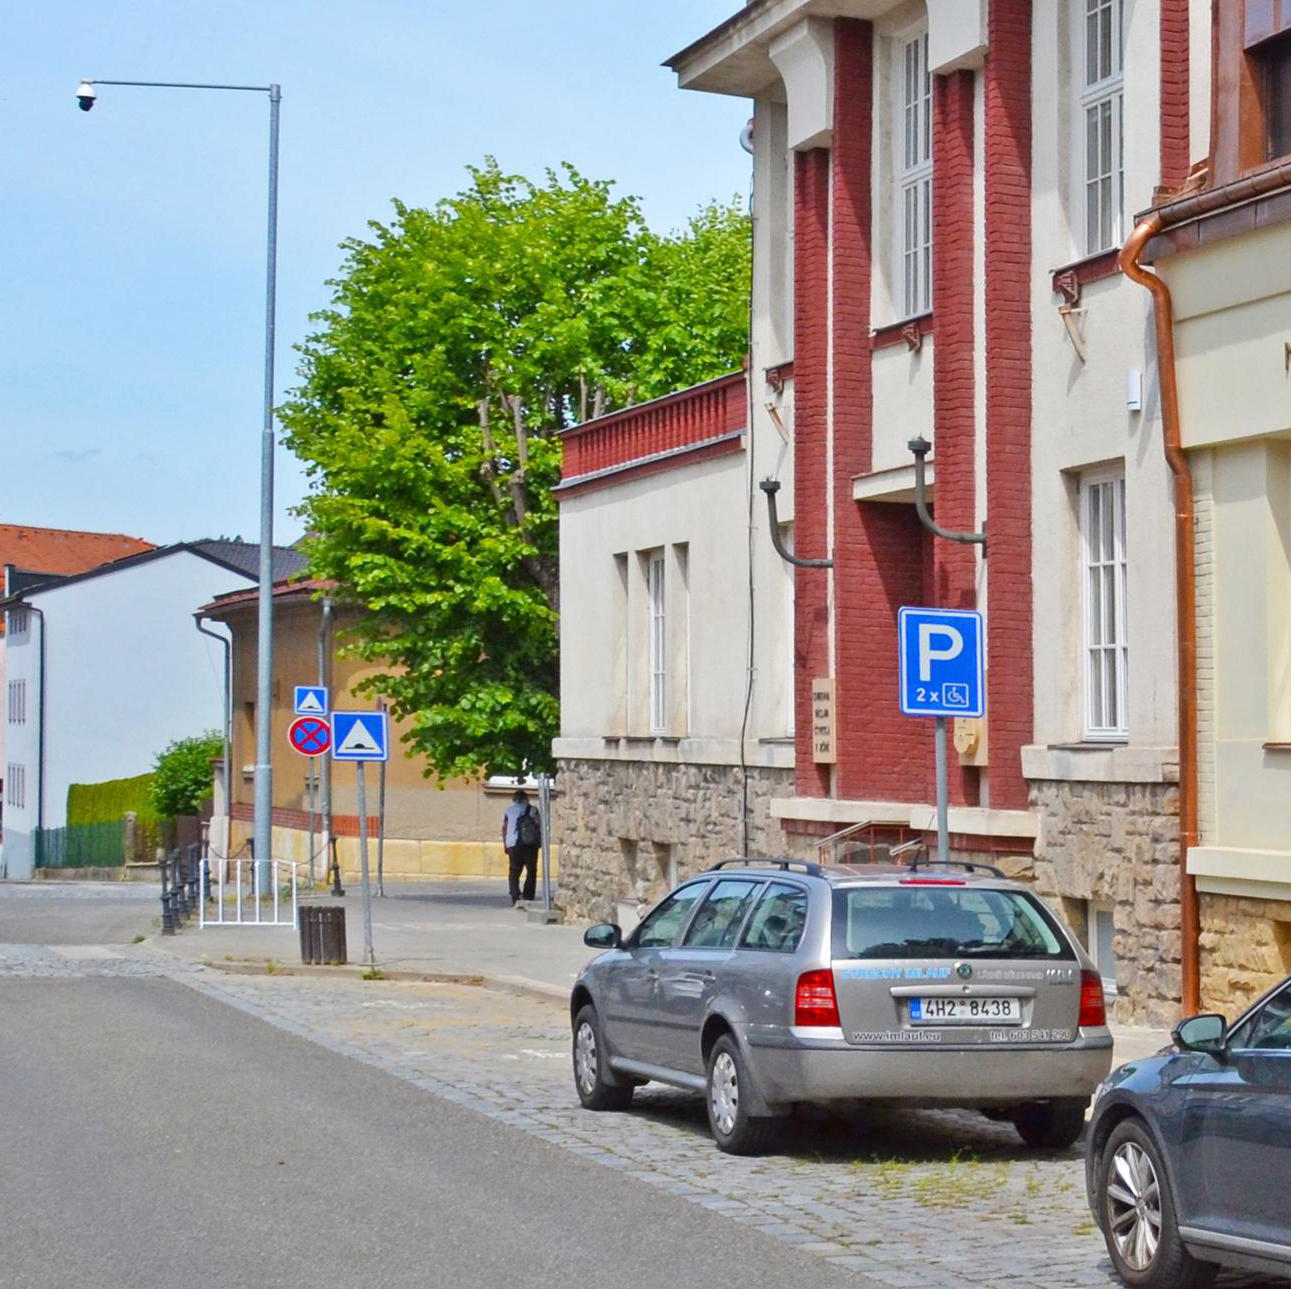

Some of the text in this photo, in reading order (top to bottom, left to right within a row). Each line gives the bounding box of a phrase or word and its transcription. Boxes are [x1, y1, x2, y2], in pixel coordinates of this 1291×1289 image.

[918, 623, 964, 682] P
[925, 999, 1012, 1016] 4H2 8438
[852, 1030, 942, 1041] www.imlauf.eu
